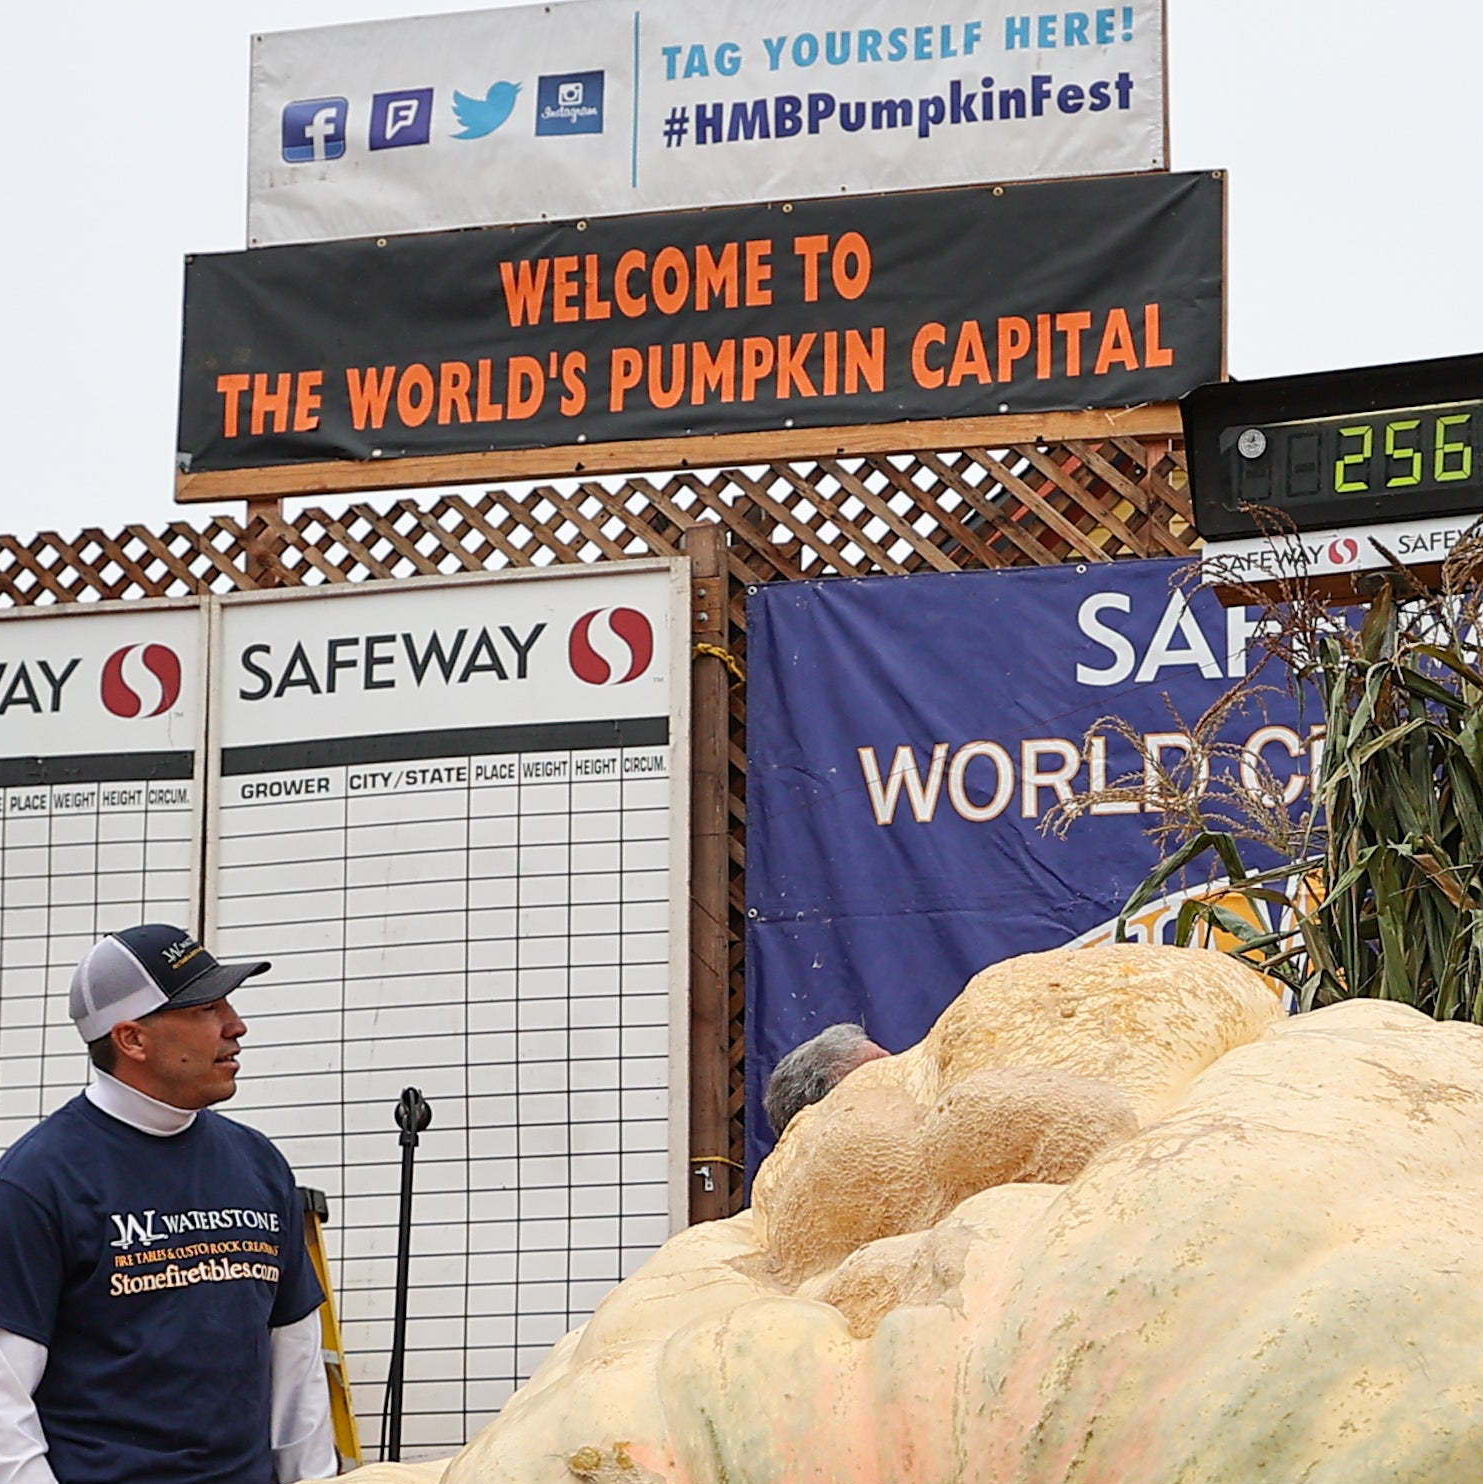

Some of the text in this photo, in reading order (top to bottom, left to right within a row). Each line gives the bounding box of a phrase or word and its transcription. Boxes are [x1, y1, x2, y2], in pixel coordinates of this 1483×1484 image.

[662, 7, 1134, 81] TAG YOURSELF HERE!
[663, 72, 1134, 148] #HMBPumpkinFest
[499, 231, 871, 328] WELCOME TO
[217, 303, 1174, 438] THE WORLD'S PUMPKIN CAPITAL
[238, 622, 548, 702] SAFEWAY
[10, 793, 47, 812] PLACE
[53, 791, 96, 810] WEIGHT
[102, 789, 143, 807] HEIGHT
[148, 787, 190, 806] CIRCUM.
[241, 755, 667, 800] GROWER CITY/STATE PLACE WEIGHT HEIGHT CIRCUM.
[857, 731, 1210, 827] WORLD
[115, 1254, 135, 1268] FIRE
[167, 1248, 176, 1260] &
[210, 1240, 242, 1255] ROCK
[161, 1209, 280, 1233] WATERSTONE
